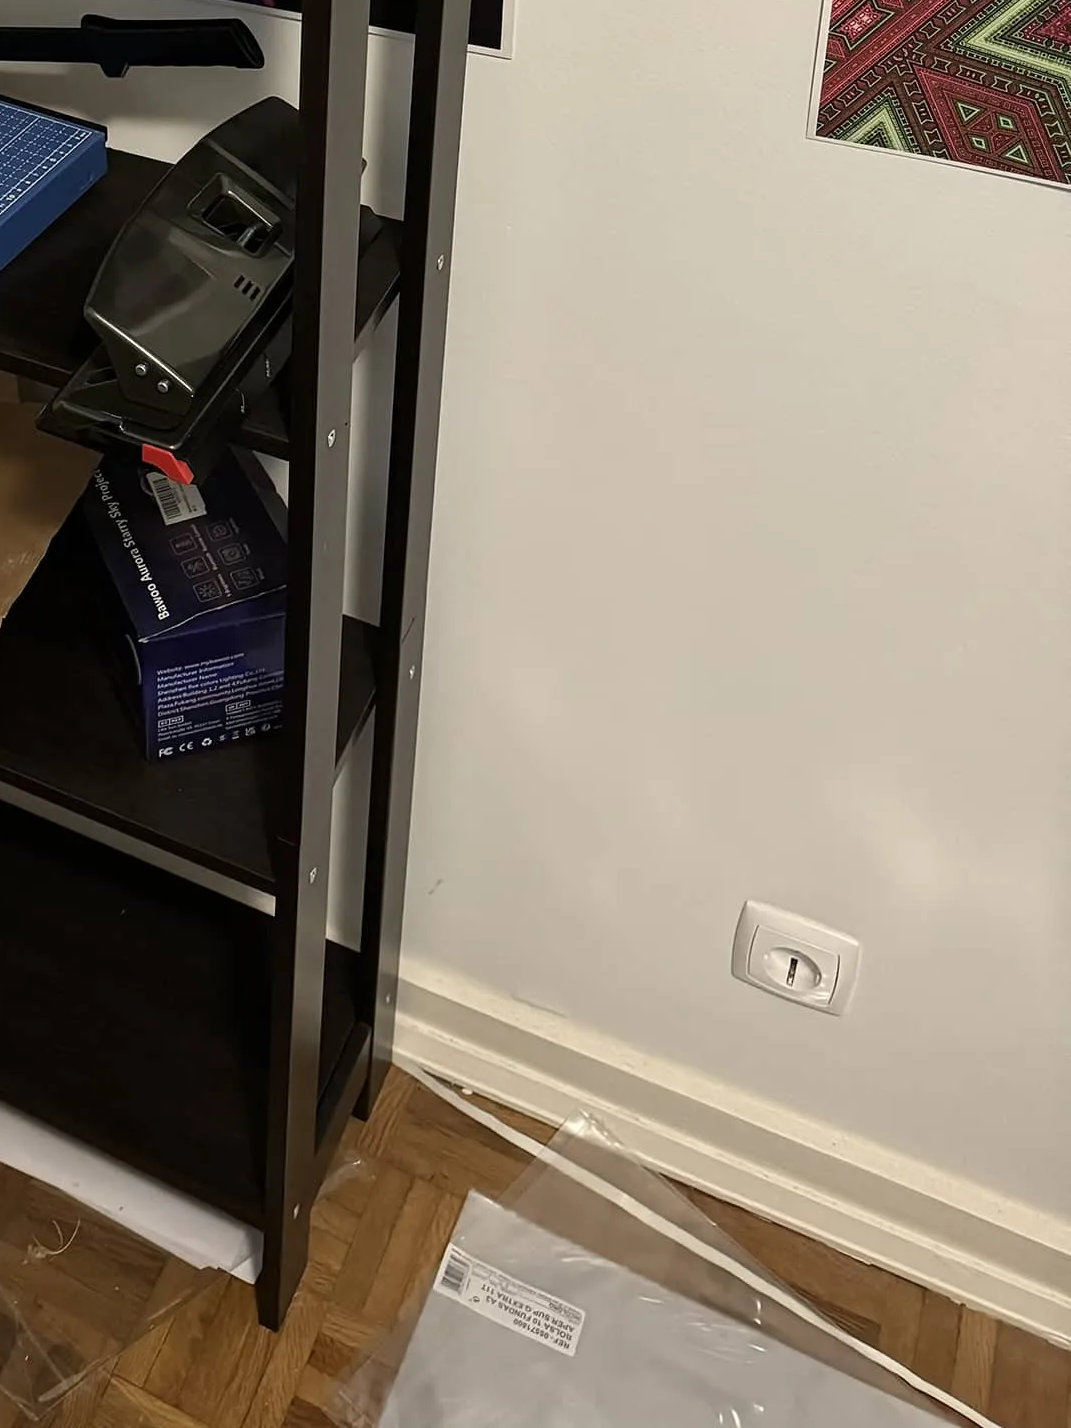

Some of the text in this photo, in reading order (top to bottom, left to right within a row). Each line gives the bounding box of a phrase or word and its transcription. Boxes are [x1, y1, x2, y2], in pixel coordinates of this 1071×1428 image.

[107, 499, 121, 518] Sky
[115, 519, 135, 548] Starry
[130, 548, 153, 582] Aurora
[147, 582, 170, 620] Bawoo
